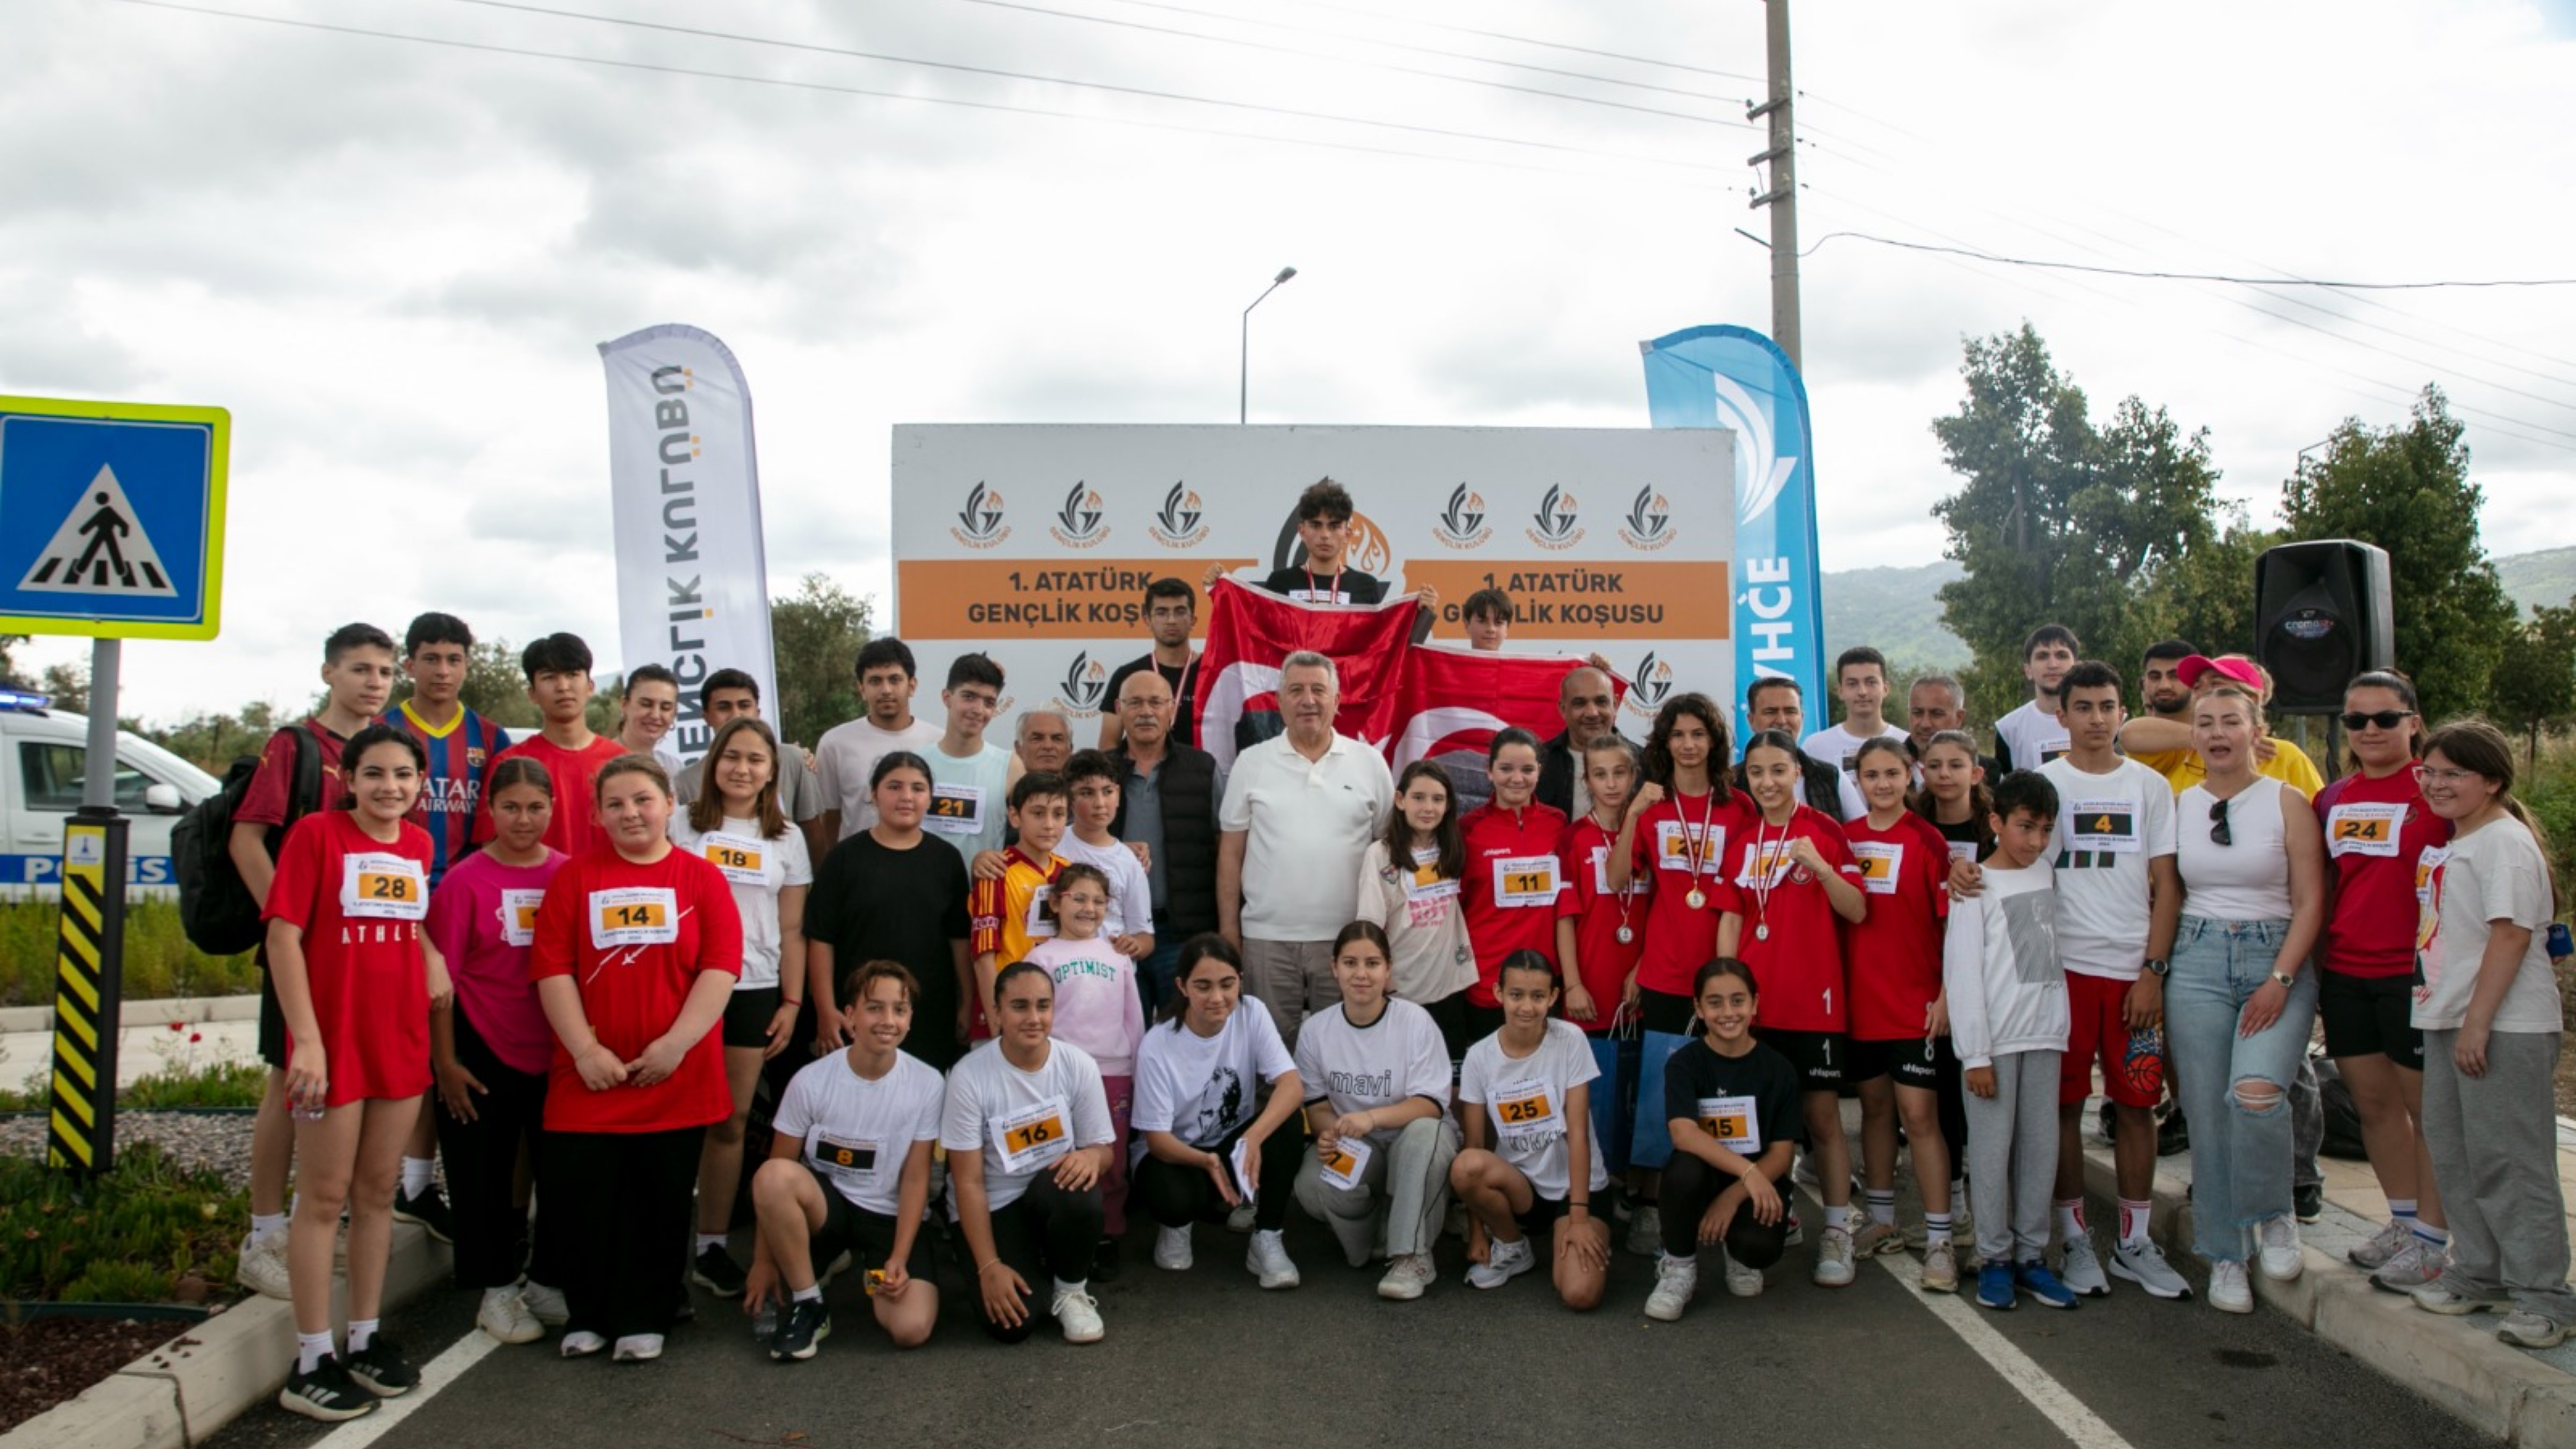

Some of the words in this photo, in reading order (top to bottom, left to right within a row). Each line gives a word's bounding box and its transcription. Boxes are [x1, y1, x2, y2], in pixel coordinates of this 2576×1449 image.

[1009, 571, 1028, 591] 1.
[1034, 567, 1153, 591] ATATÜRK
[1508, 568, 1624, 592] ATATÜRK
[968, 598, 1081, 628] GENÇLİK
[1088, 603, 1148, 628] KOŞ
[1443, 598, 1554, 623] GLİK
[1560, 603, 1663, 629] KOŞUSU
[422, 777, 480, 800] ATAR
[415, 797, 475, 814] AIRWAY
[938, 799, 964, 817] 21
[2094, 814, 2113, 833] 4
[2342, 821, 2378, 839] 24
[719, 849, 746, 867] 18
[24, 857, 167, 882] PİS
[374, 876, 406, 898] 28
[1518, 875, 1539, 891] 11
[617, 906, 649, 925] 14
[1054, 960, 1117, 983] OPTIMIST
[1822, 987, 1832, 1015] 1
[1822, 1038, 1831, 1065] 1
[1329, 1069, 1392, 1097] mavi
[1508, 1100, 1539, 1121] 25
[1019, 1124, 1048, 1144] 16
[1708, 1119, 1734, 1137] 15
[837, 1149, 853, 1166] 8
